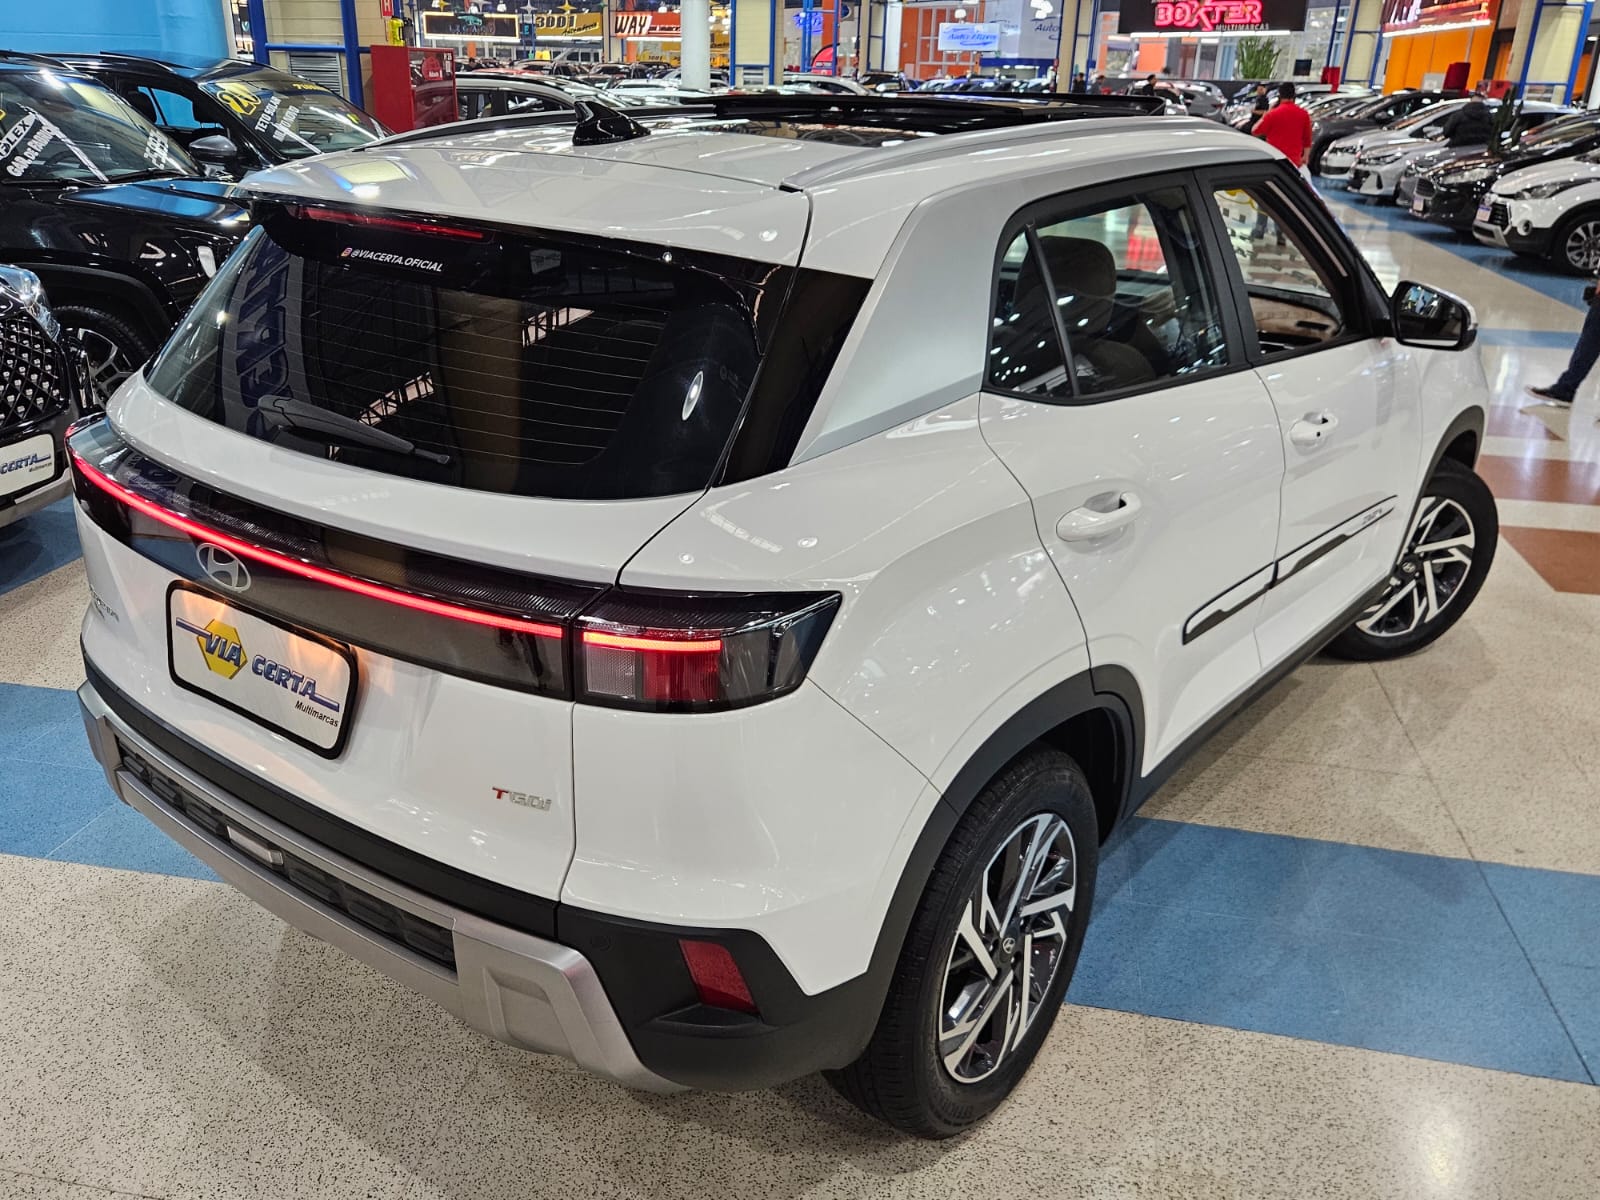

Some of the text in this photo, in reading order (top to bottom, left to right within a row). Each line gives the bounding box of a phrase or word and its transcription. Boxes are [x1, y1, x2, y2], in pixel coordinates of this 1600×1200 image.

[535, 13, 577, 29] 3001
[615, 15, 651, 35] WAY
[1154, 0, 1262, 31] BOXTER
[255, 113, 272, 132] TETO
[350, 249, 443, 272] @VIACERTA.OFICIAL
[205, 635, 319, 700] VIA CERTA
[295, 700, 339, 728] Multimarcas
